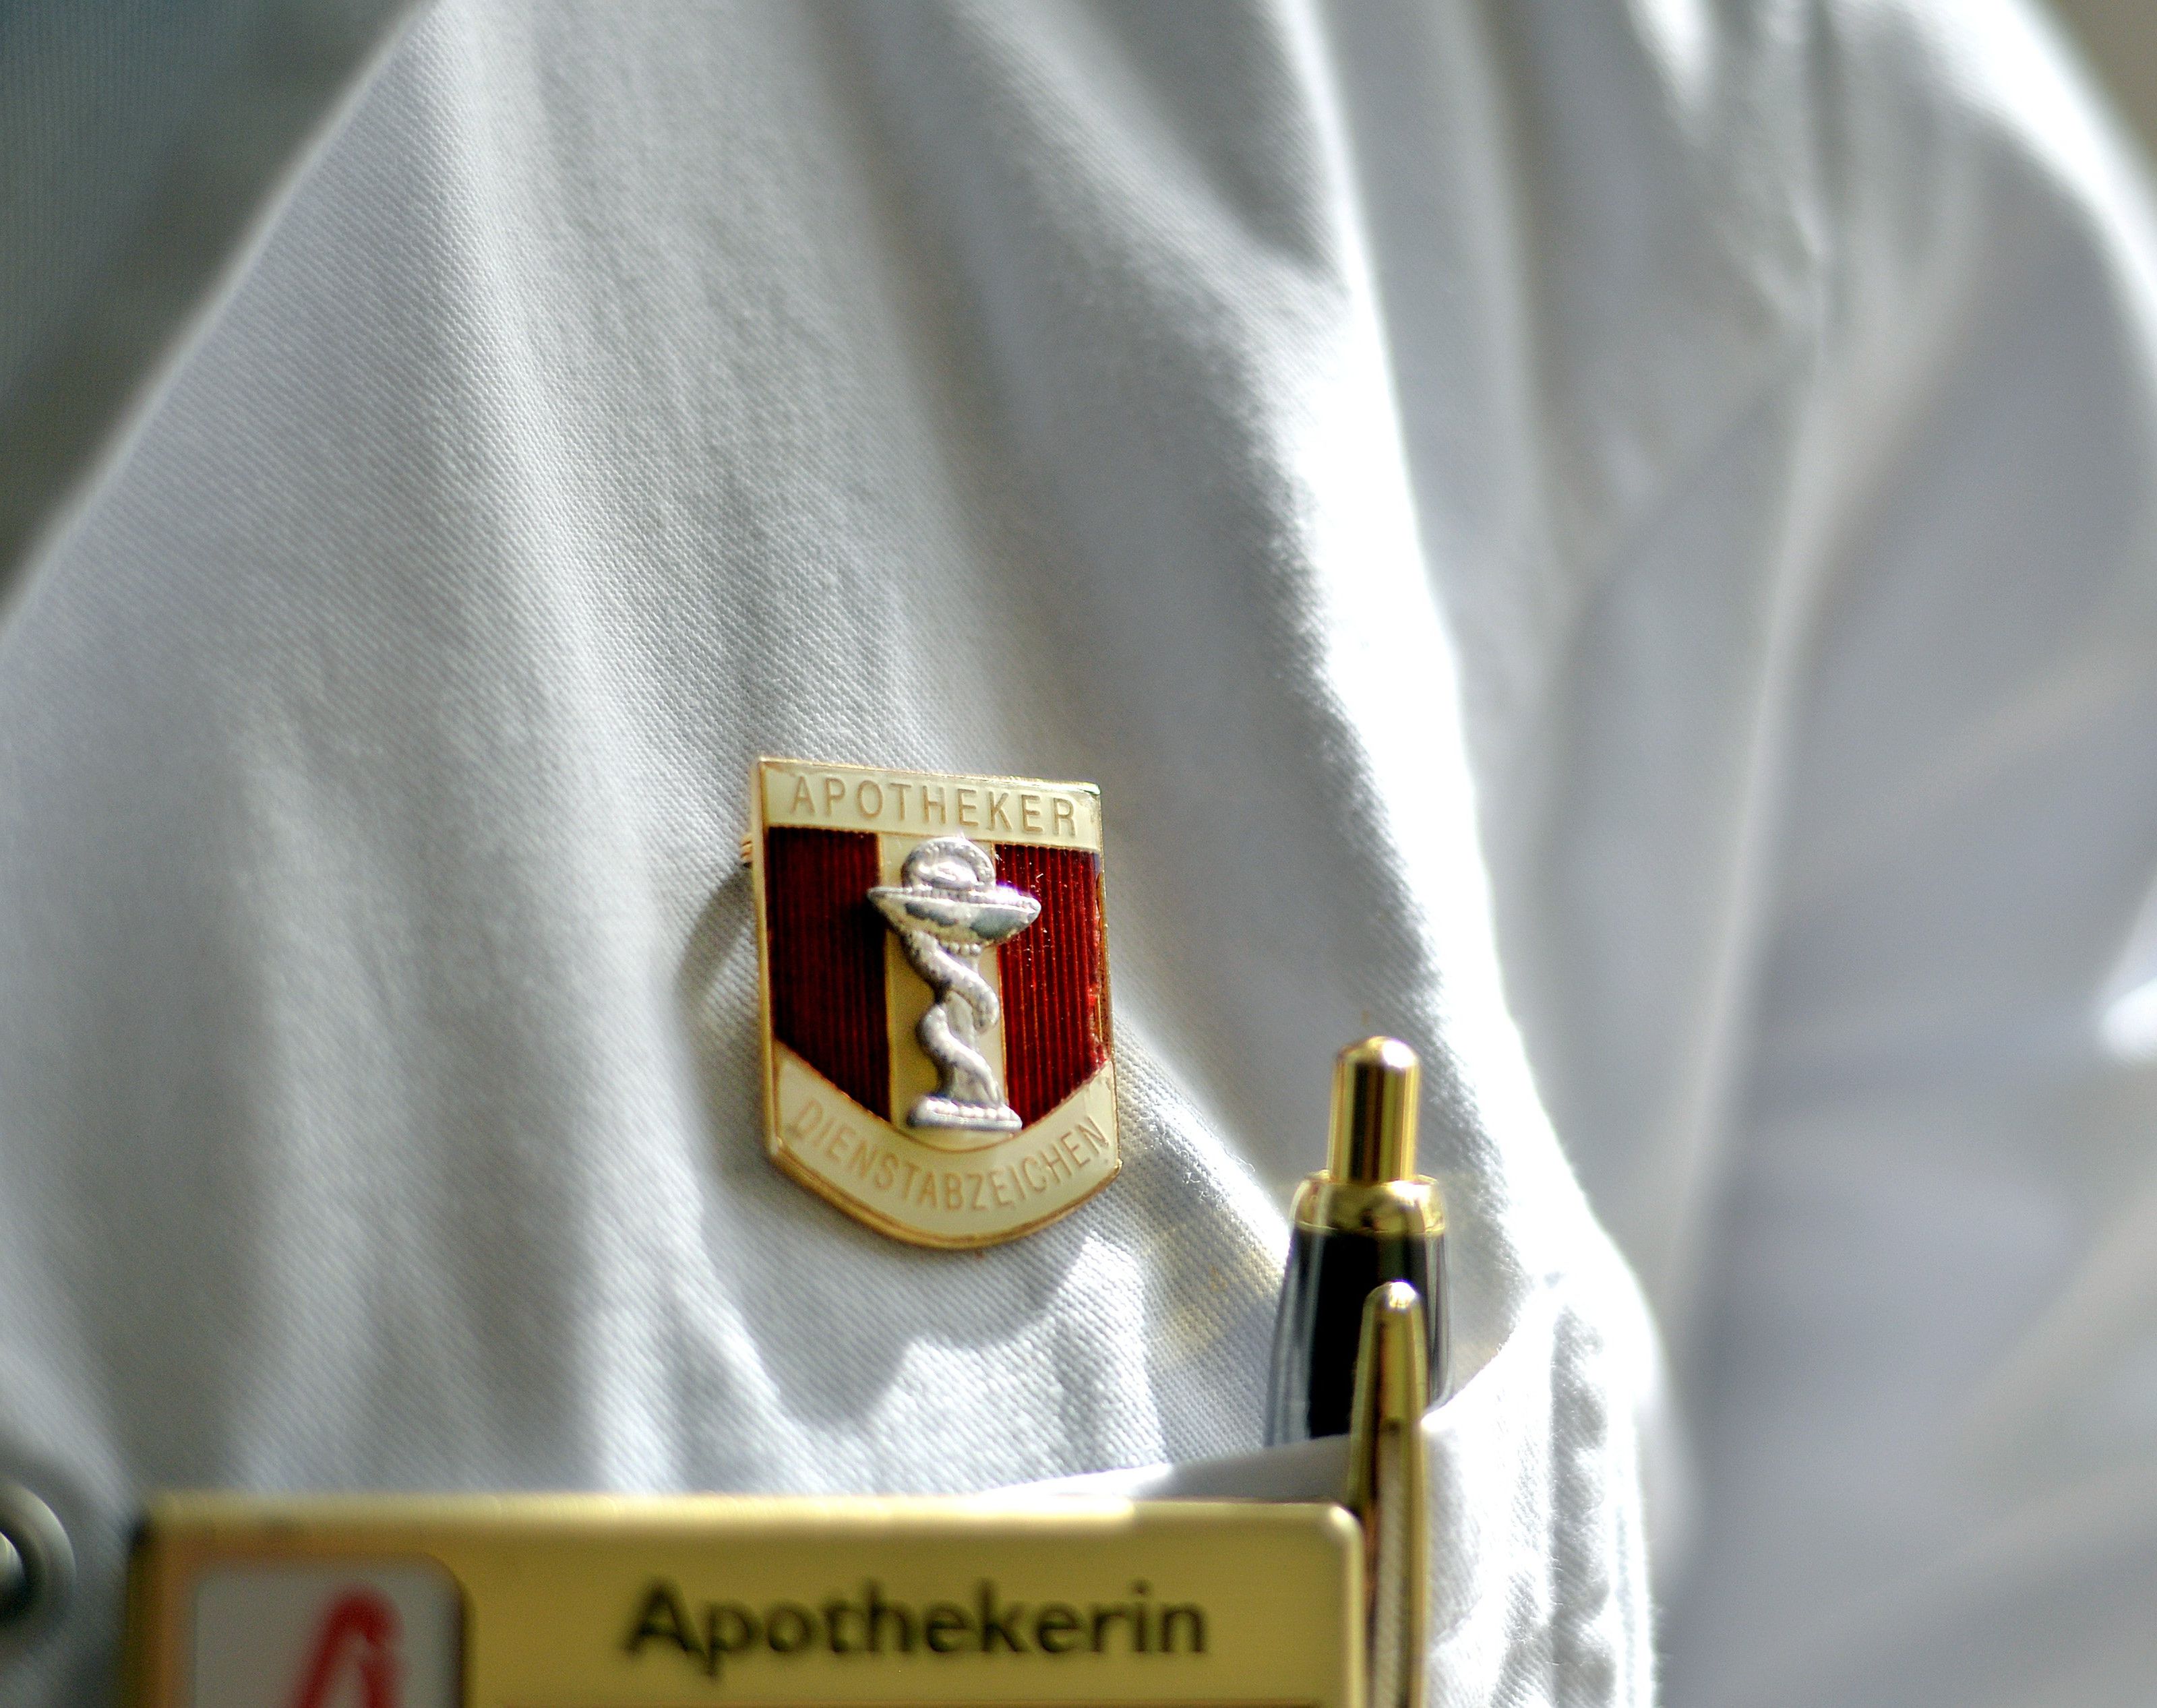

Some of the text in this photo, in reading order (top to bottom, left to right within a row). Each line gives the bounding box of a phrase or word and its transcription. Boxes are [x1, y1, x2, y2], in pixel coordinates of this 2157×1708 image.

[789, 775, 1078, 837] APOTHEKER
[787, 1098, 1110, 1212] DIENSTABZEICHEN
[624, 1576, 1209, 1680] Apothekerin
